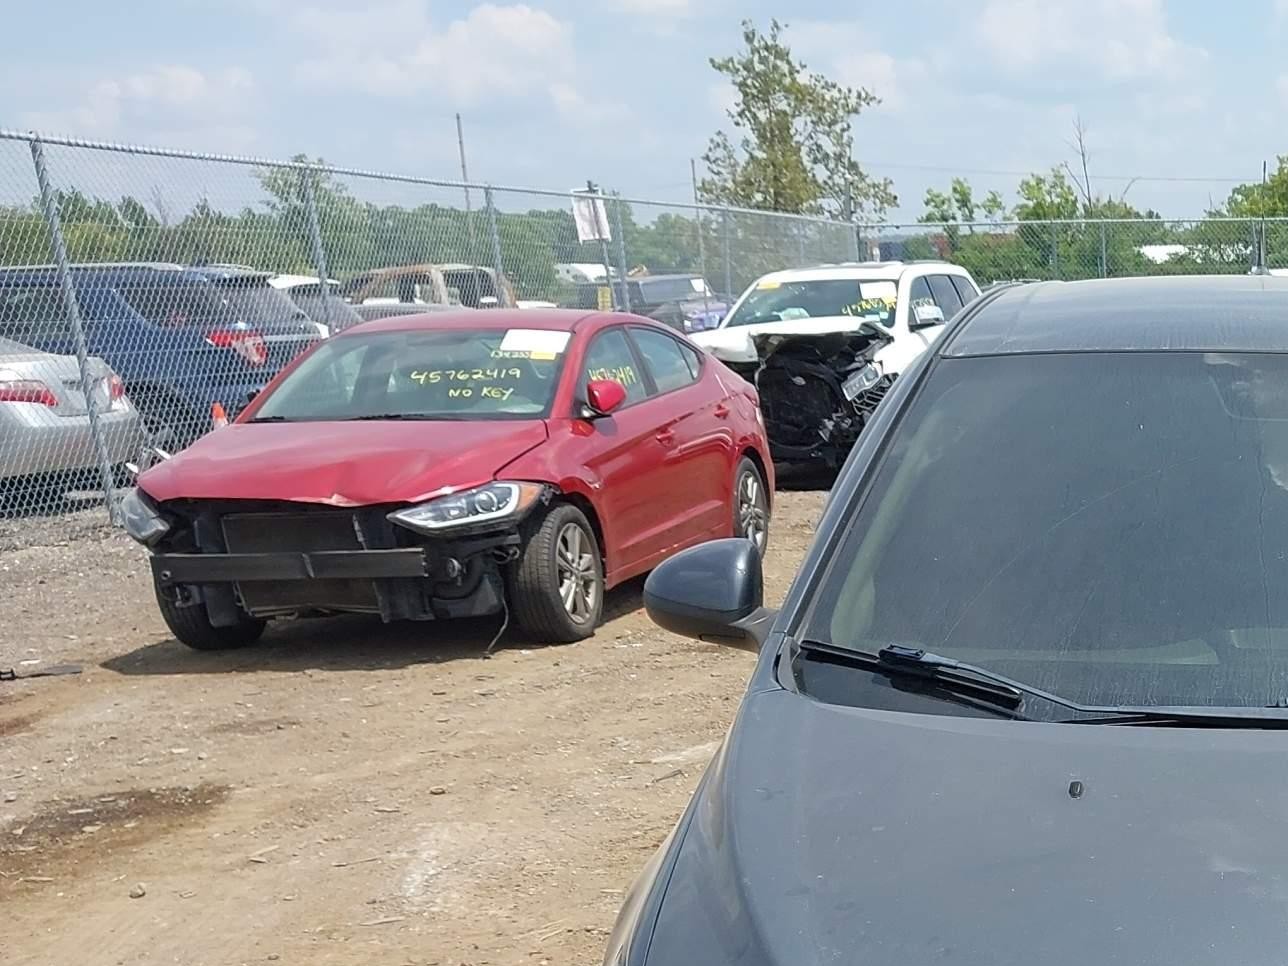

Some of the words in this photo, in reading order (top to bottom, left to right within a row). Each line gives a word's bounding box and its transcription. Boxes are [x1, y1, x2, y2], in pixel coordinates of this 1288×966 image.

[411, 368, 521, 384] 45762419
[449, 389, 473, 397] NO
[481, 387, 514, 400] KEY
